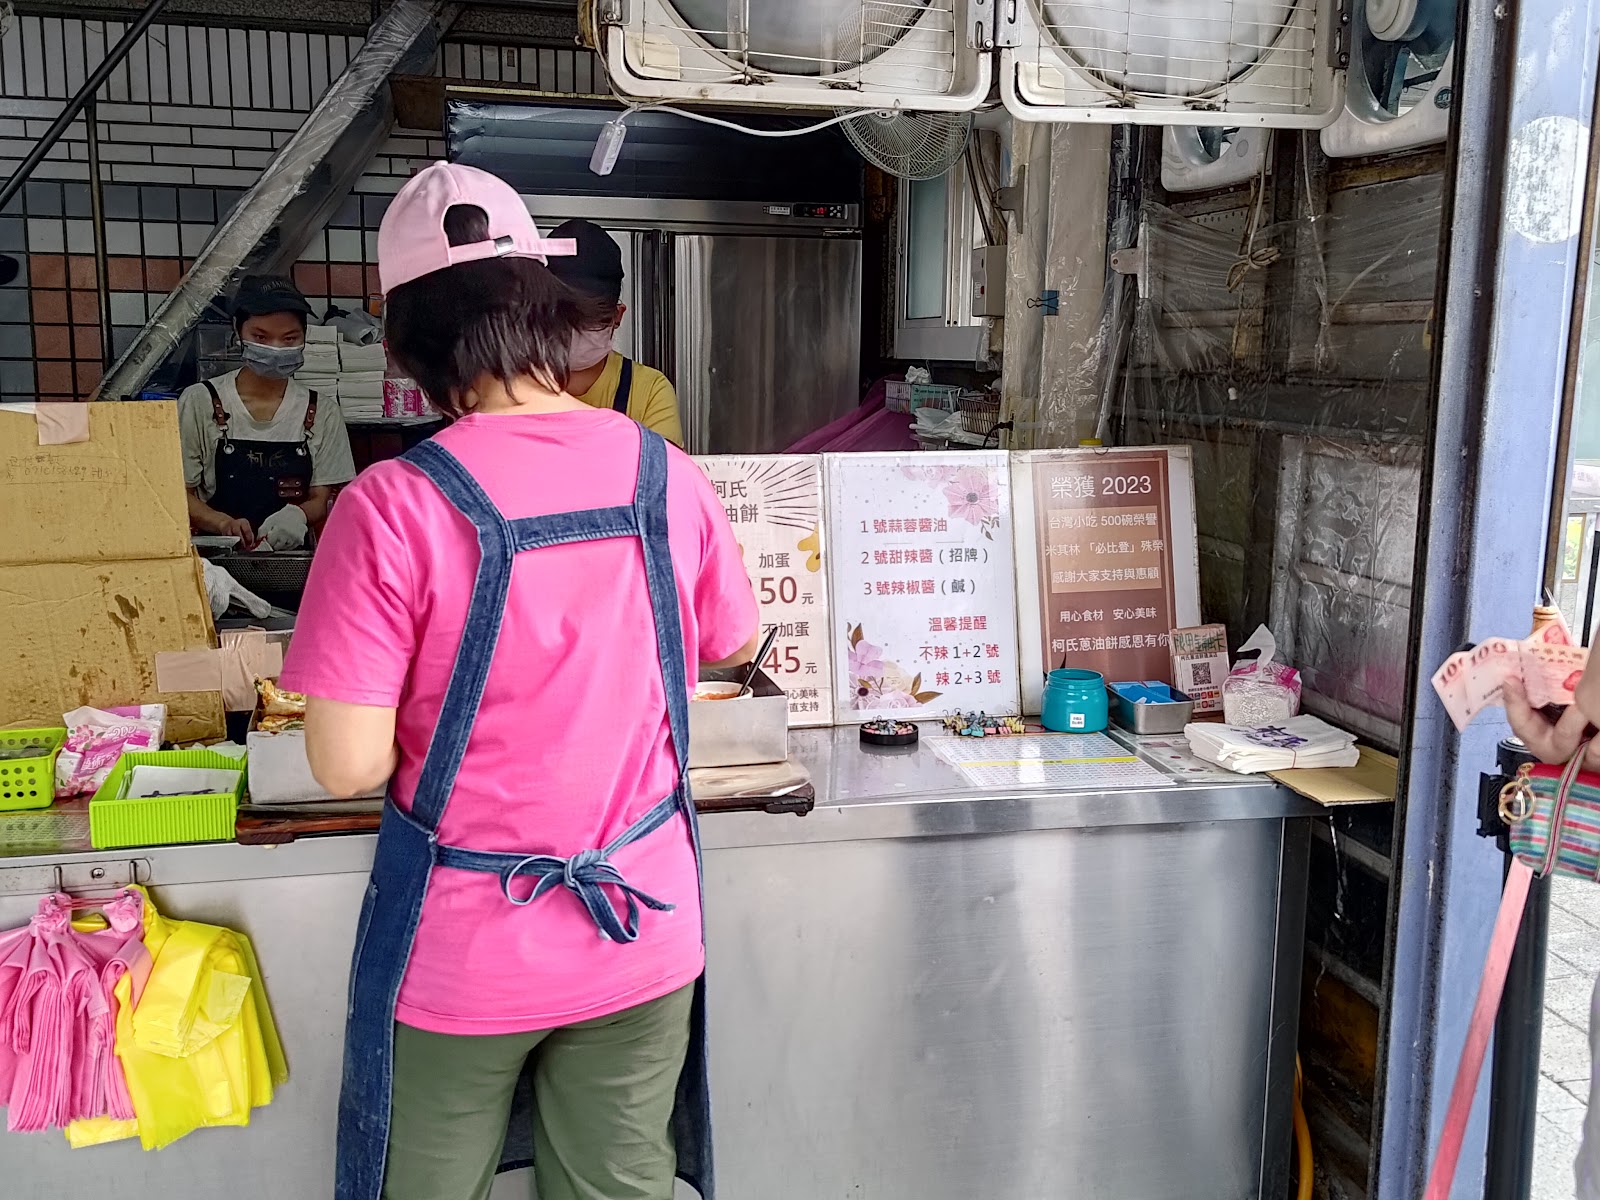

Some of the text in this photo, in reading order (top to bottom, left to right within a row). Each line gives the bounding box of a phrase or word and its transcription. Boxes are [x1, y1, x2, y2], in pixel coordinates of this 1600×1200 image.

[1051, 475, 1152, 499] 榮獲 2023
[860, 517, 948, 534] 1 號蒜蓉醬油
[1049, 515, 1098, 529] 台灣小吃
[758, 552, 790, 568] 加蛋
[861, 551, 869, 565] 2
[1052, 566, 1160, 583] 感謝大家支持與惠顧
[760, 576, 814, 605] 50 元
[864, 582, 872, 595] 3
[1060, 607, 1158, 623] 用心食材 安心美味
[762, 621, 810, 637] 不加蛋
[928, 615, 987, 632] 溫馨提醒
[762, 646, 817, 674] 45 元
[919, 644, 999, 660] 不辣 1+2 號
[936, 669, 1001, 686] 辣 2+3 號
[787, 702, 819, 713] 直支持
